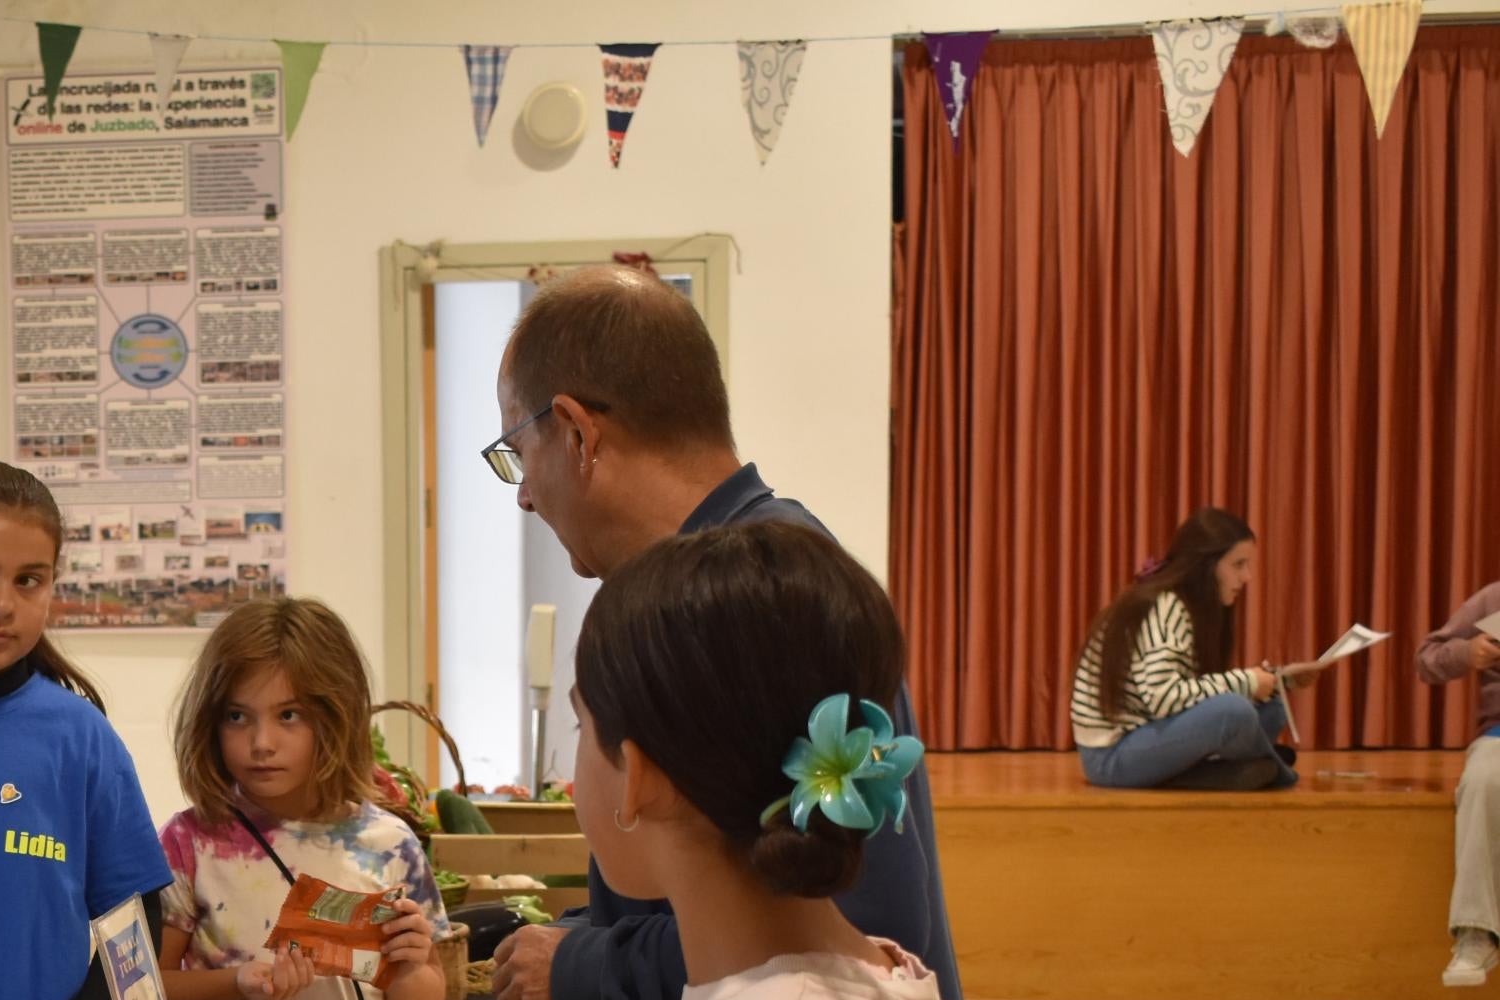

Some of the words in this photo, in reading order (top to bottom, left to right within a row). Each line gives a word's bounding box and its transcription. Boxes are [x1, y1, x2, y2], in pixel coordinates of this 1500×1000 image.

[55, 80, 141, 98] ncrucijada
[185, 81, 194, 91] a
[199, 77, 246, 91] través
[61, 102, 81, 114] las
[87, 100, 134, 114] redes:
[139, 98, 152, 112] la
[156, 95, 246, 114] xperiencia
[17, 121, 62, 135] online
[67, 121, 86, 133] de
[91, 118, 159, 132] Juzbado,
[164, 115, 248, 130] Salamanca
[4, 829, 67, 862] Lidia
